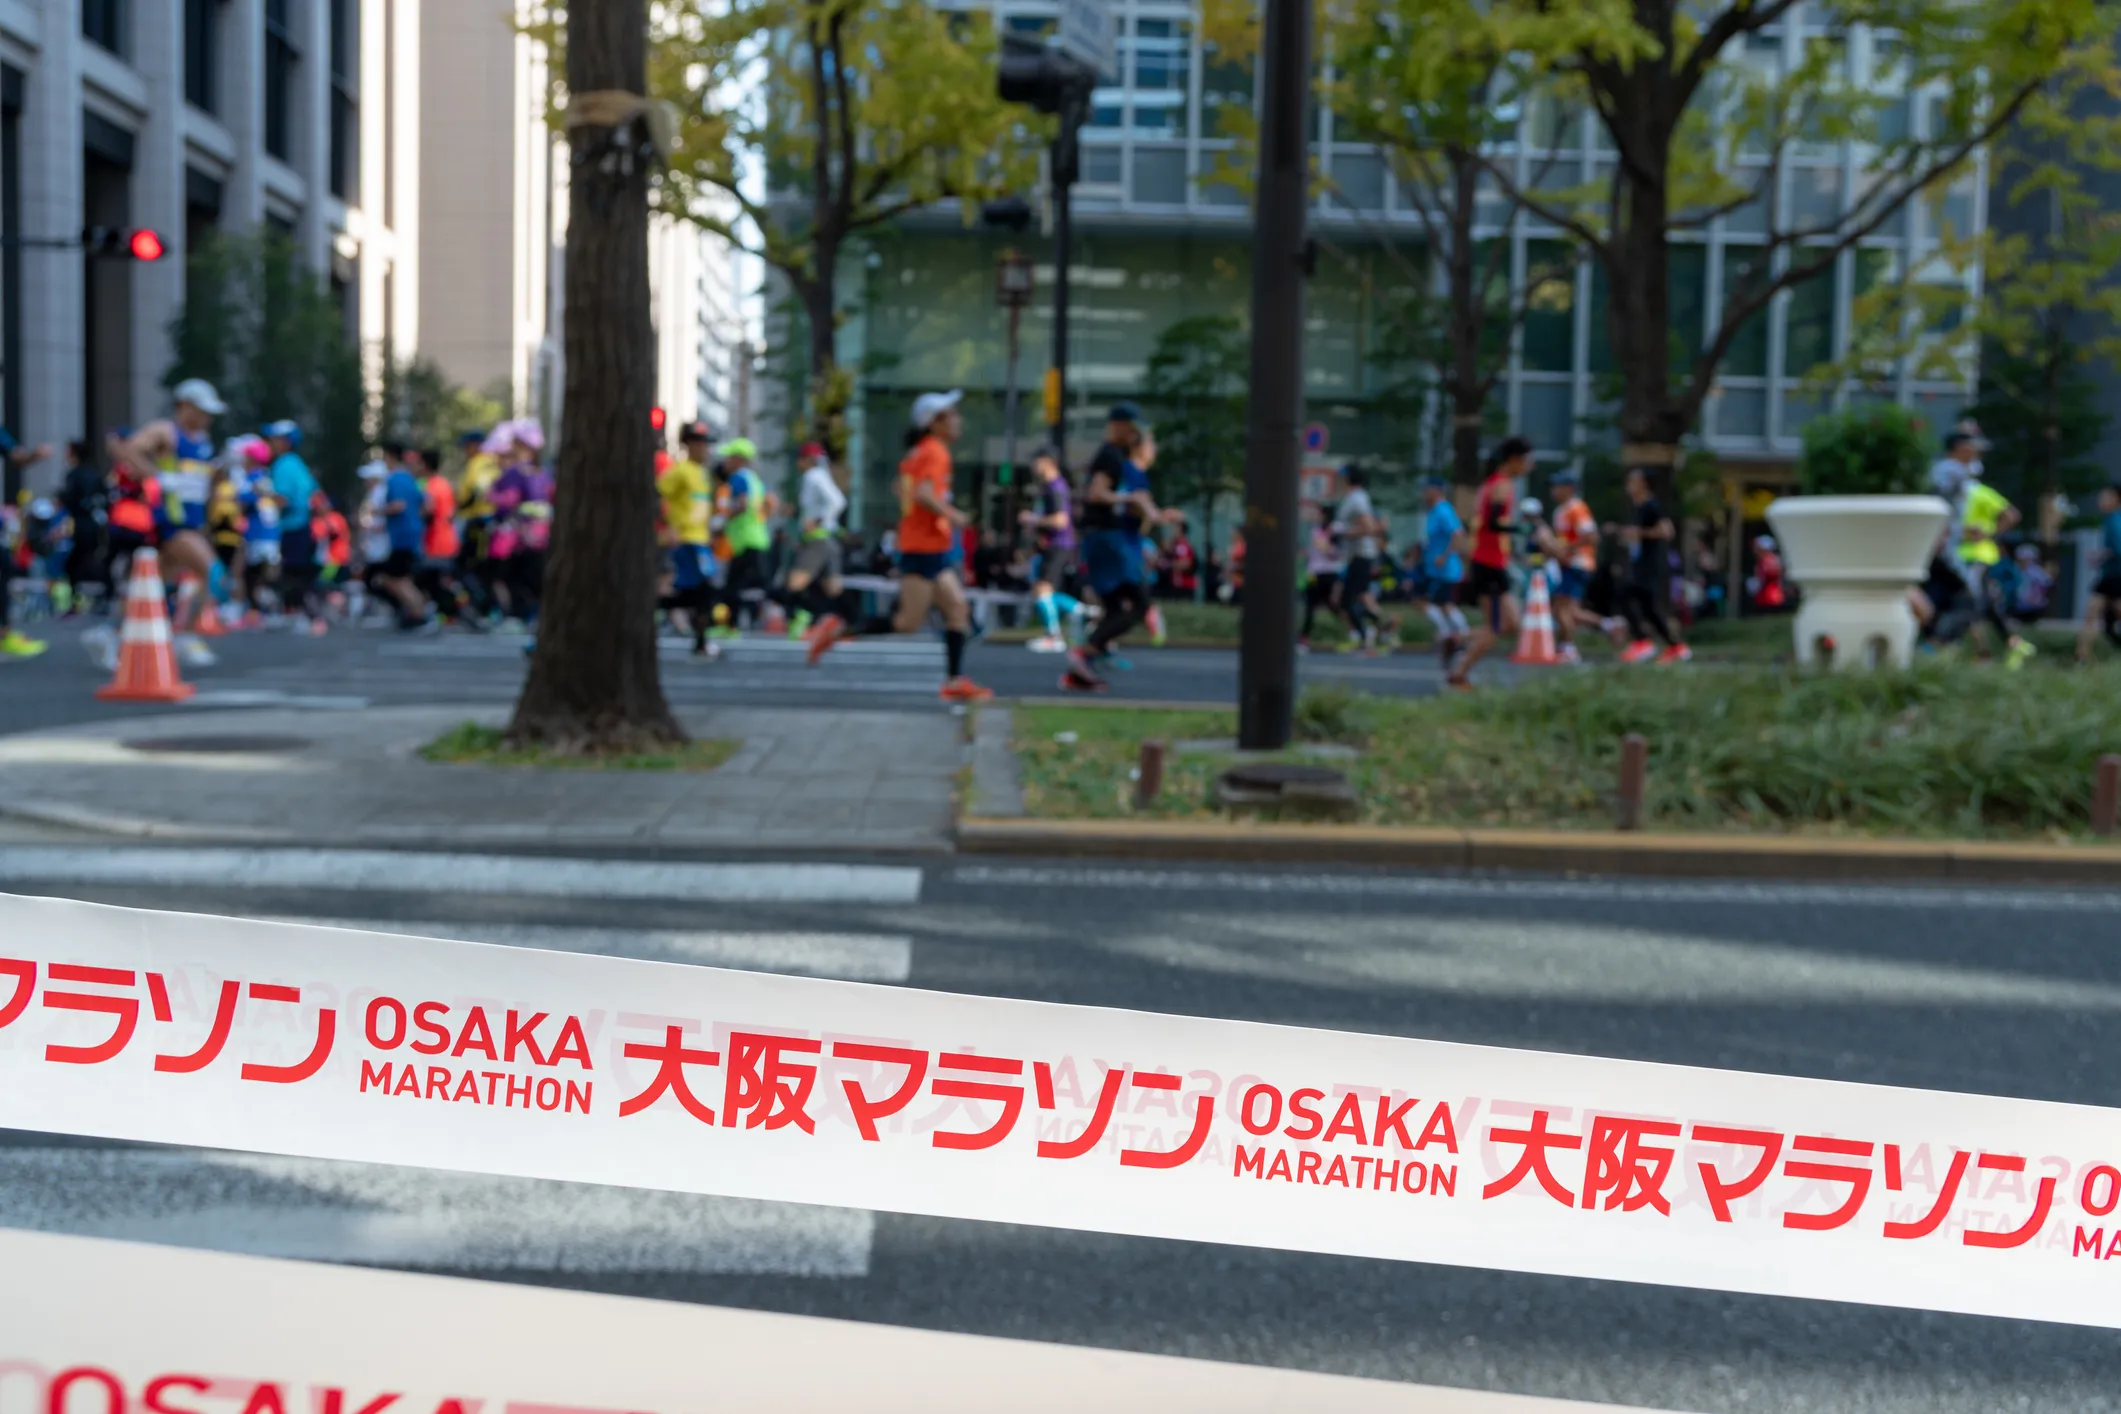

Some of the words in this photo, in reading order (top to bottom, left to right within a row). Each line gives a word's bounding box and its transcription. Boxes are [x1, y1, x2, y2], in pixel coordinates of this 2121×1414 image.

[366, 997, 592, 1069] OSAKA
[360, 1060, 592, 1114] MARATHON
[620, 1026, 1214, 1168] 大阪マラソン
[1241, 1084, 1458, 1153] OSAKA
[1234, 1145, 1457, 1196] MARATHON
[1483, 1110, 2056, 1248] 大阪マラソン
